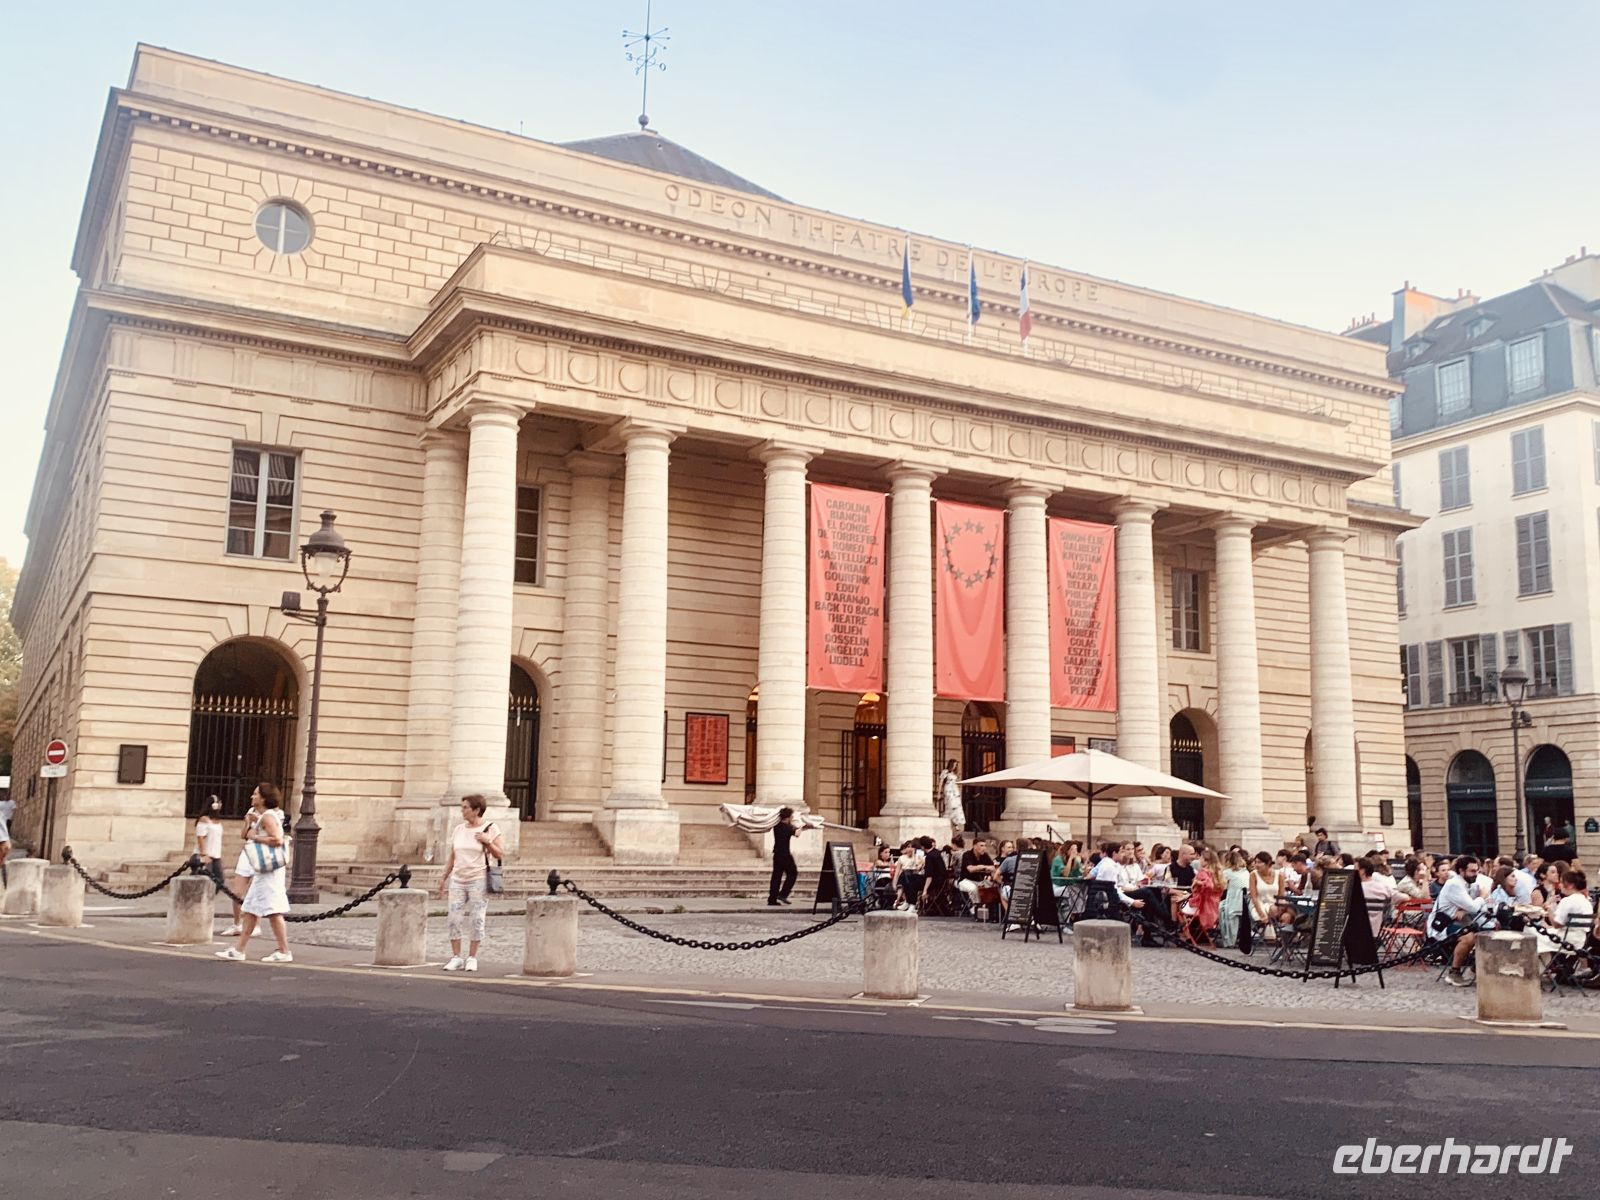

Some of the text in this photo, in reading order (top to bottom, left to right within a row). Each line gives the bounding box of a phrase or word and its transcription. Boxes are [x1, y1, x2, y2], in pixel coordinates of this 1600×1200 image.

[664, 184, 772, 225] ODEON
[788, 213, 921, 262] THEATRE
[936, 251, 969, 272] DE
[826, 499, 871, 513] CAROLINA
[830, 510, 868, 524] BIANCHI
[827, 520, 871, 534] EL CONDE
[832, 541, 865, 553] ROMEO
[818, 550, 878, 566] CASTELLUCCI
[830, 561, 867, 574] MYRIAM
[1073, 561, 1092, 572] LUPA
[824, 571, 870, 585] GOURFINK
[836, 583, 860, 593] EDDY
[825, 592, 870, 605] D'ARANJO
[815, 601, 880, 617] BACK TO BACK
[828, 613, 868, 626] THEATRE
[831, 624, 863, 636] JULIEN
[1067, 628, 1099, 639] HUBERT
[825, 634, 870, 647] GOSSELIN
[829, 655, 865, 667] LIDDELL
[1063, 666, 1073, 675] LE
